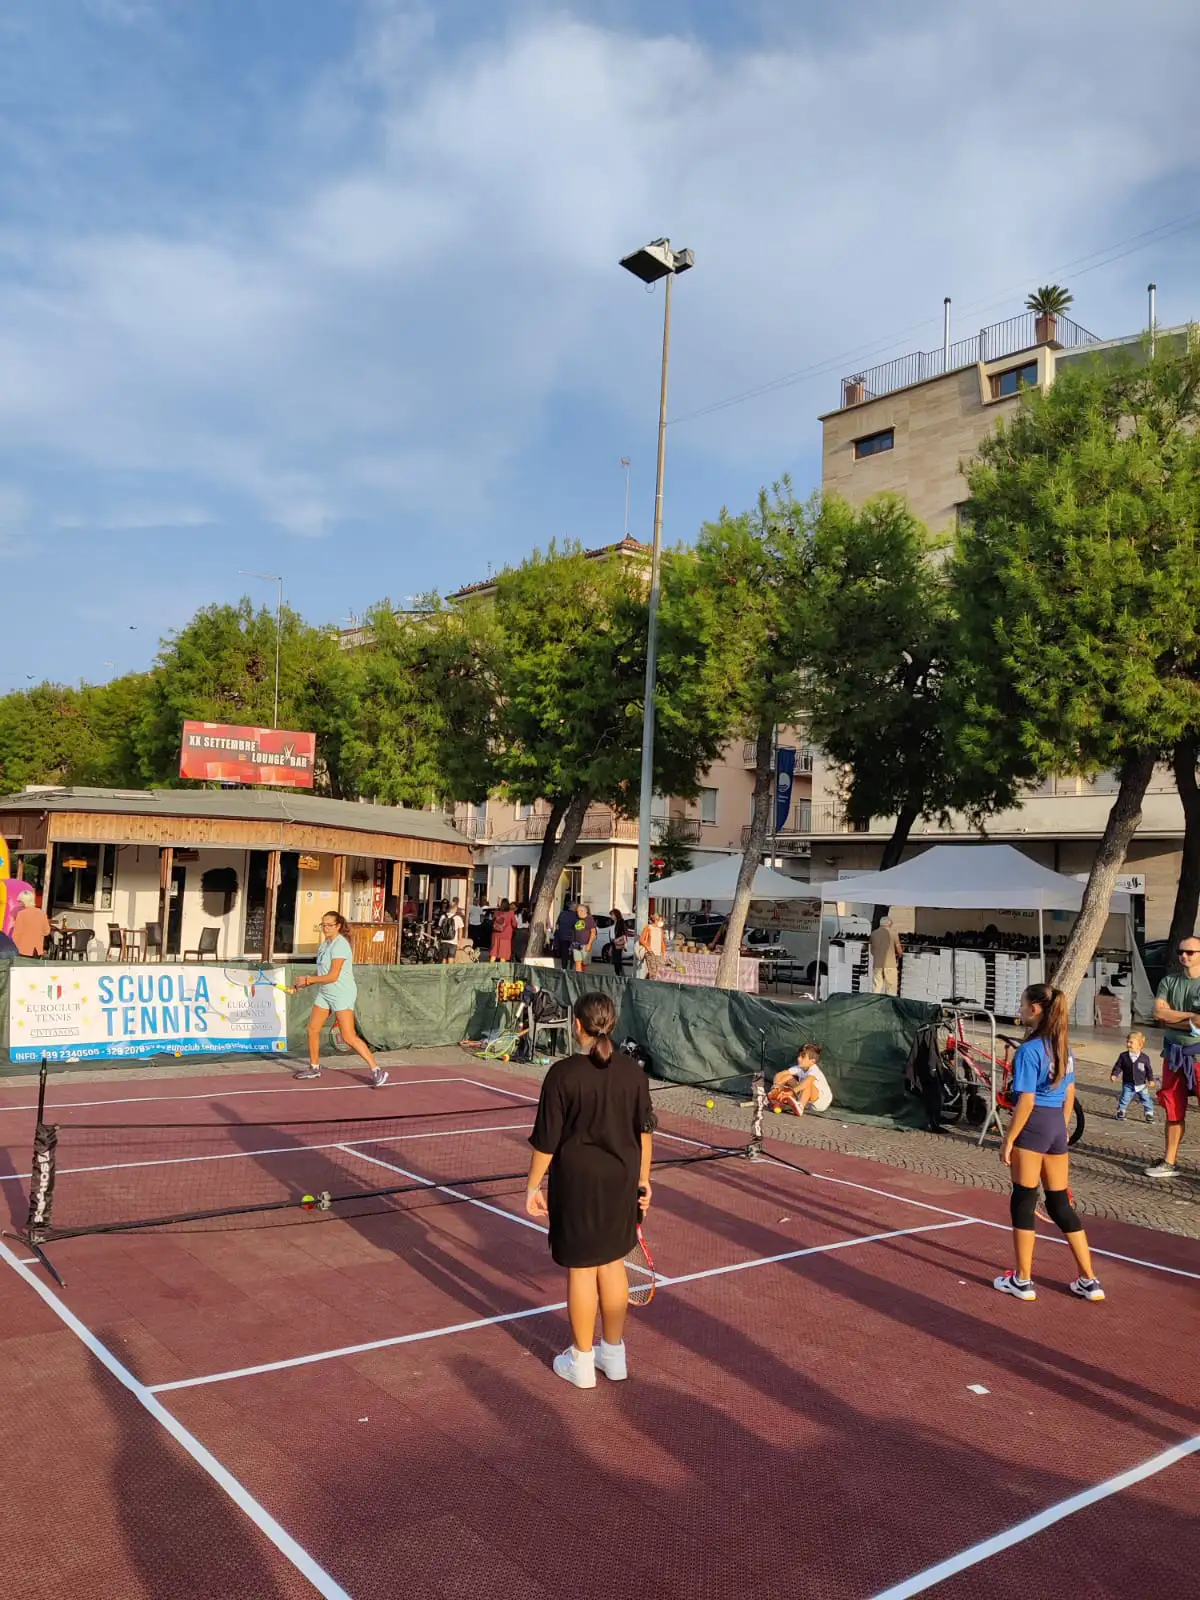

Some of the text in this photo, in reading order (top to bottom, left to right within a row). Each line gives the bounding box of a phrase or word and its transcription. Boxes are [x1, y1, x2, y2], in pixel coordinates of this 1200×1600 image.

[190, 735, 256, 752] XX SETTEMBRE
[252, 752, 307, 768] LOUNGE BAR
[98, 974, 210, 1005] SCUOLA
[26, 1003, 81, 1013] EUROCLUB
[35, 1013, 72, 1023] TENNIS
[102, 1005, 209, 1037] TENNIS
